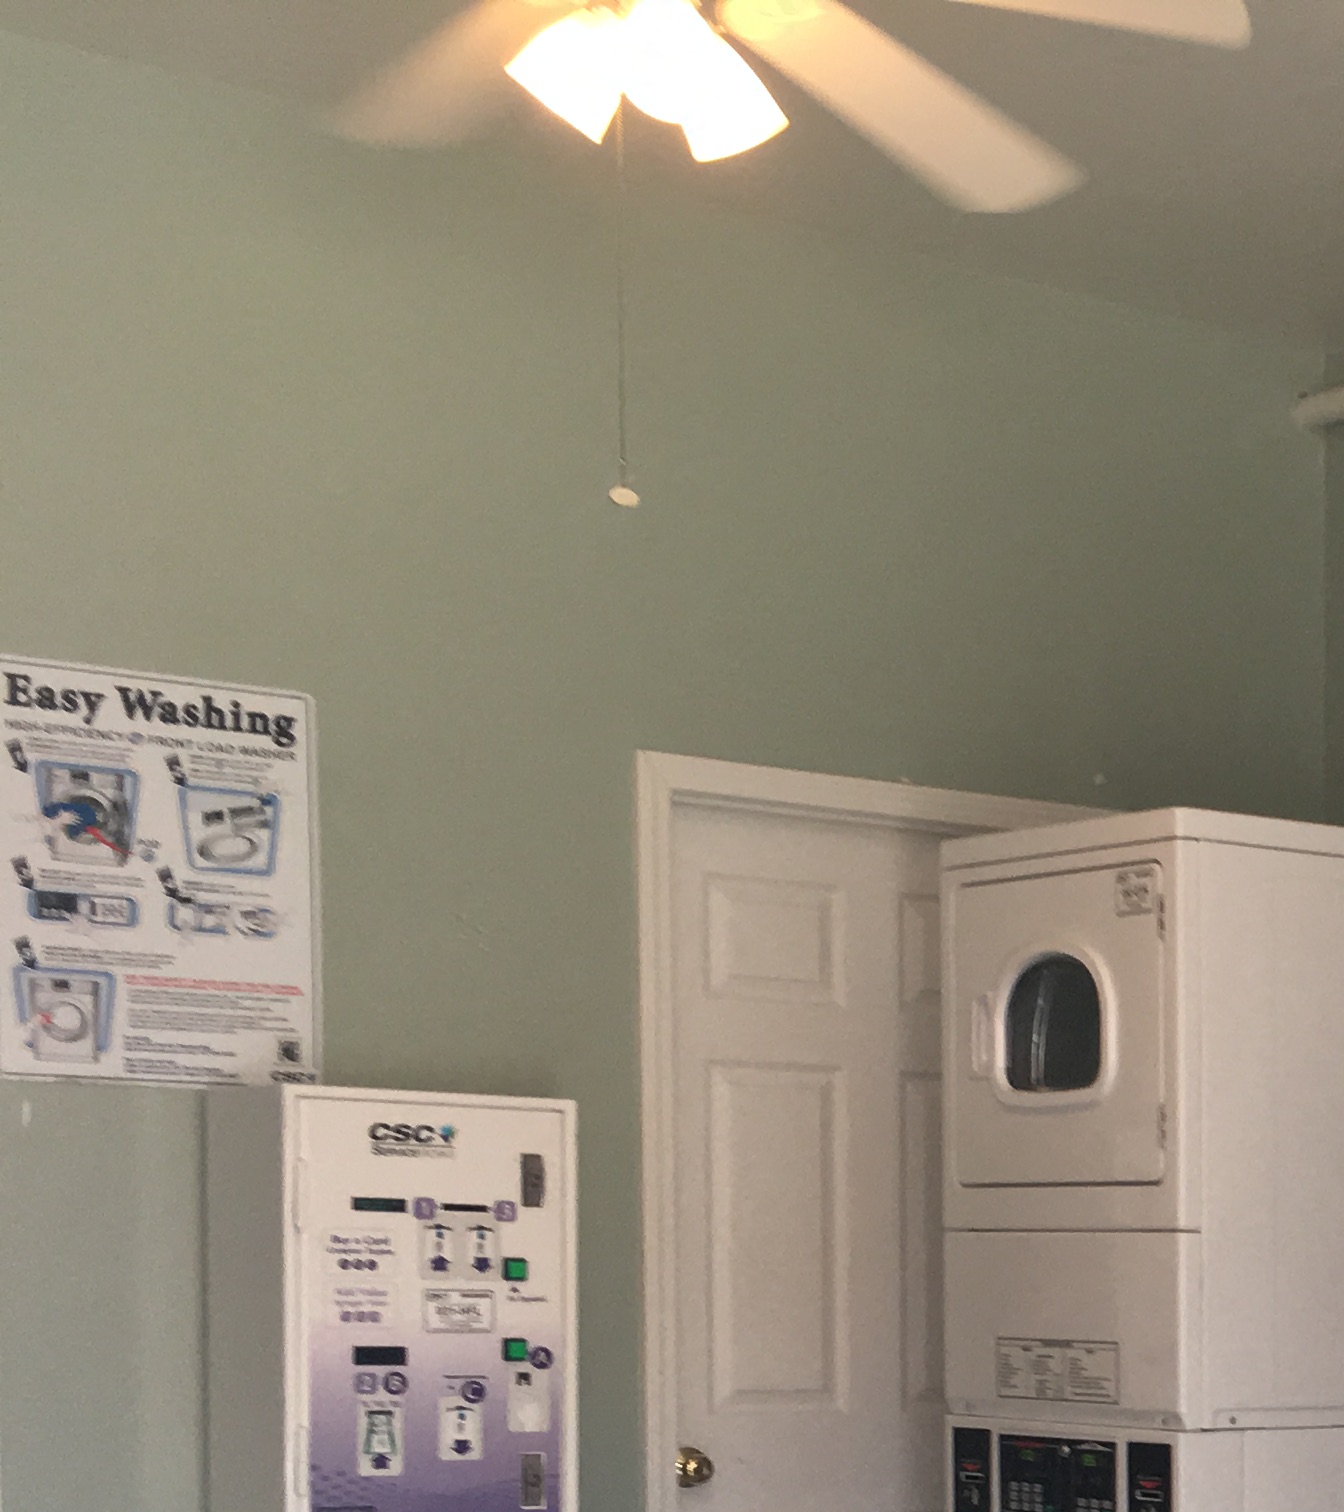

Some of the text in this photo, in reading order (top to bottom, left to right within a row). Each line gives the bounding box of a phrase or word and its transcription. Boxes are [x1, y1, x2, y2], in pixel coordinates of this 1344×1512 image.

[3, 671, 298, 748] Easy Washing
[148, 734, 193, 749] FRONT
[197, 738, 235, 752] LOAD
[238, 744, 297, 761] WASHER
[368, 1122, 435, 1143] CSC
